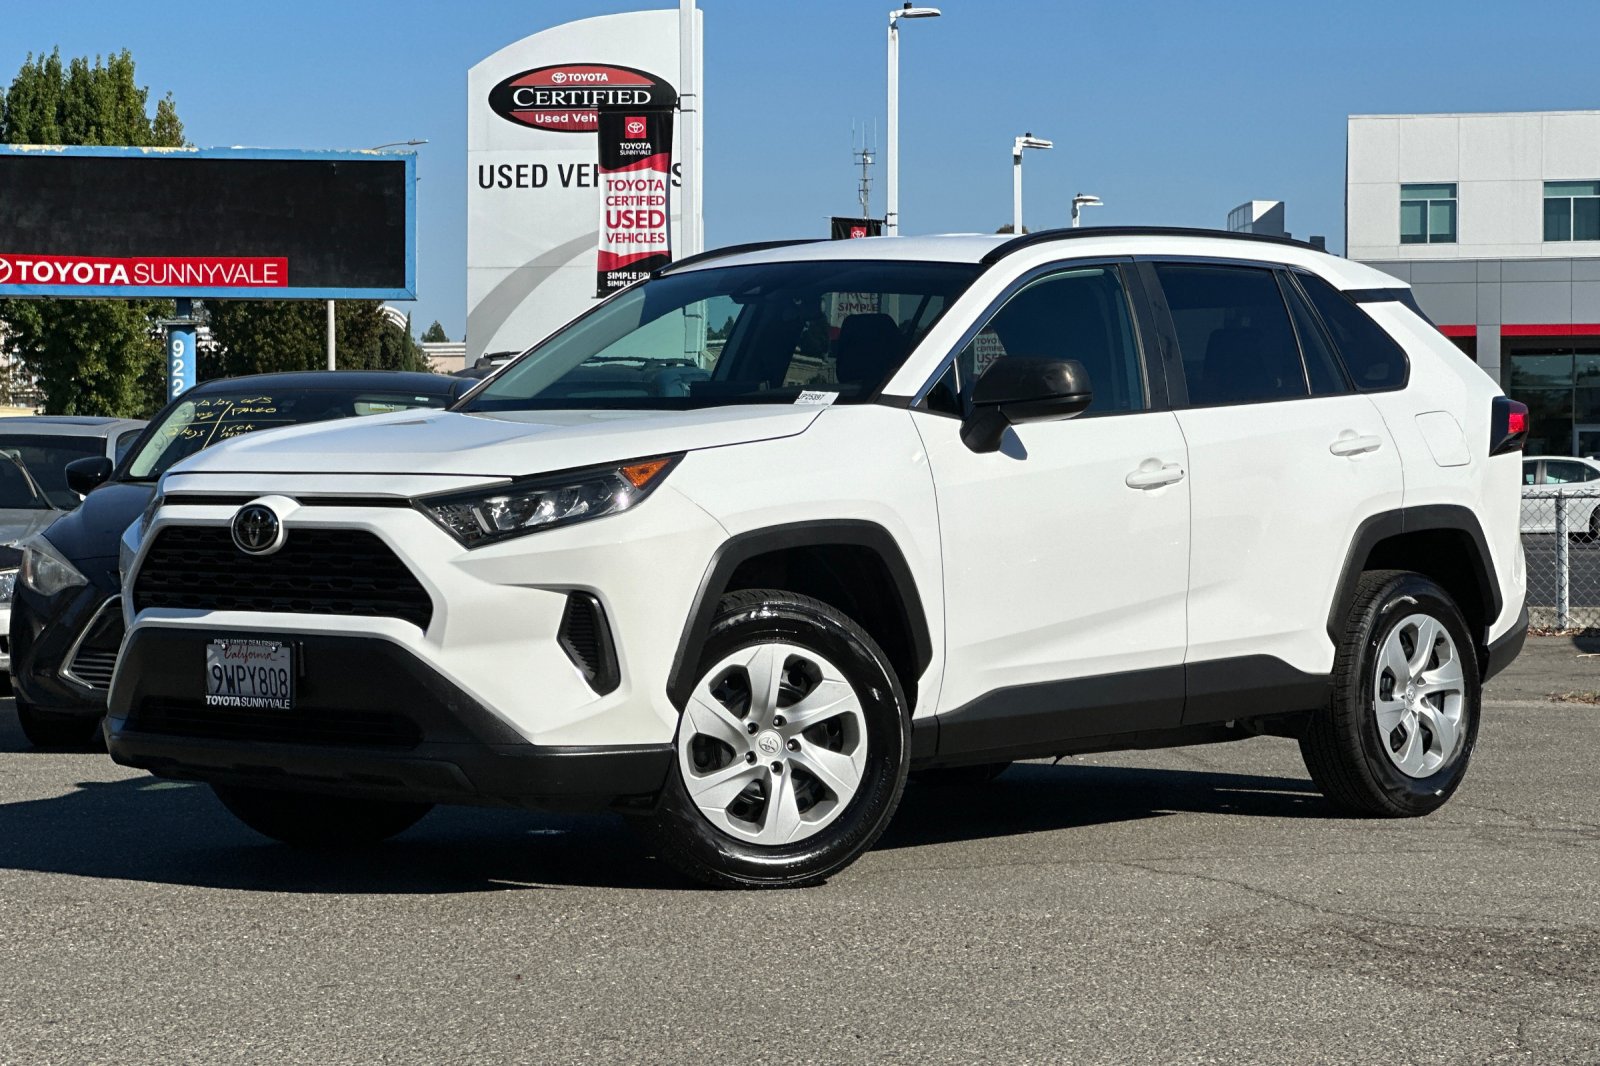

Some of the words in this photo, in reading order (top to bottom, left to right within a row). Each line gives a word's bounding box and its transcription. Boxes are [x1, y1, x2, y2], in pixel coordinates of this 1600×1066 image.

[567, 73, 609, 82] TOYOTA
[534, 113, 569, 123] Used
[619, 142, 652, 150] TOYOTA
[478, 164, 549, 189] USED
[606, 178, 665, 192] TOYOTA
[605, 195, 666, 207] CERTIFIED
[606, 209, 666, 229] USED
[606, 232, 666, 244] VEHICLES
[16, 261, 131, 285] TOYOTA
[133, 262, 279, 285] SUNNYVALE
[606, 271, 637, 280] SIMPLE
[838, 303, 878, 312] SIMPLE
[976, 354, 998, 363] USE
[223, 643, 278, 664] California
[212, 664, 289, 698] 9WPY808
[205, 695, 241, 707] TOYOTA
[240, 696, 290, 709] SUNNYVALE
